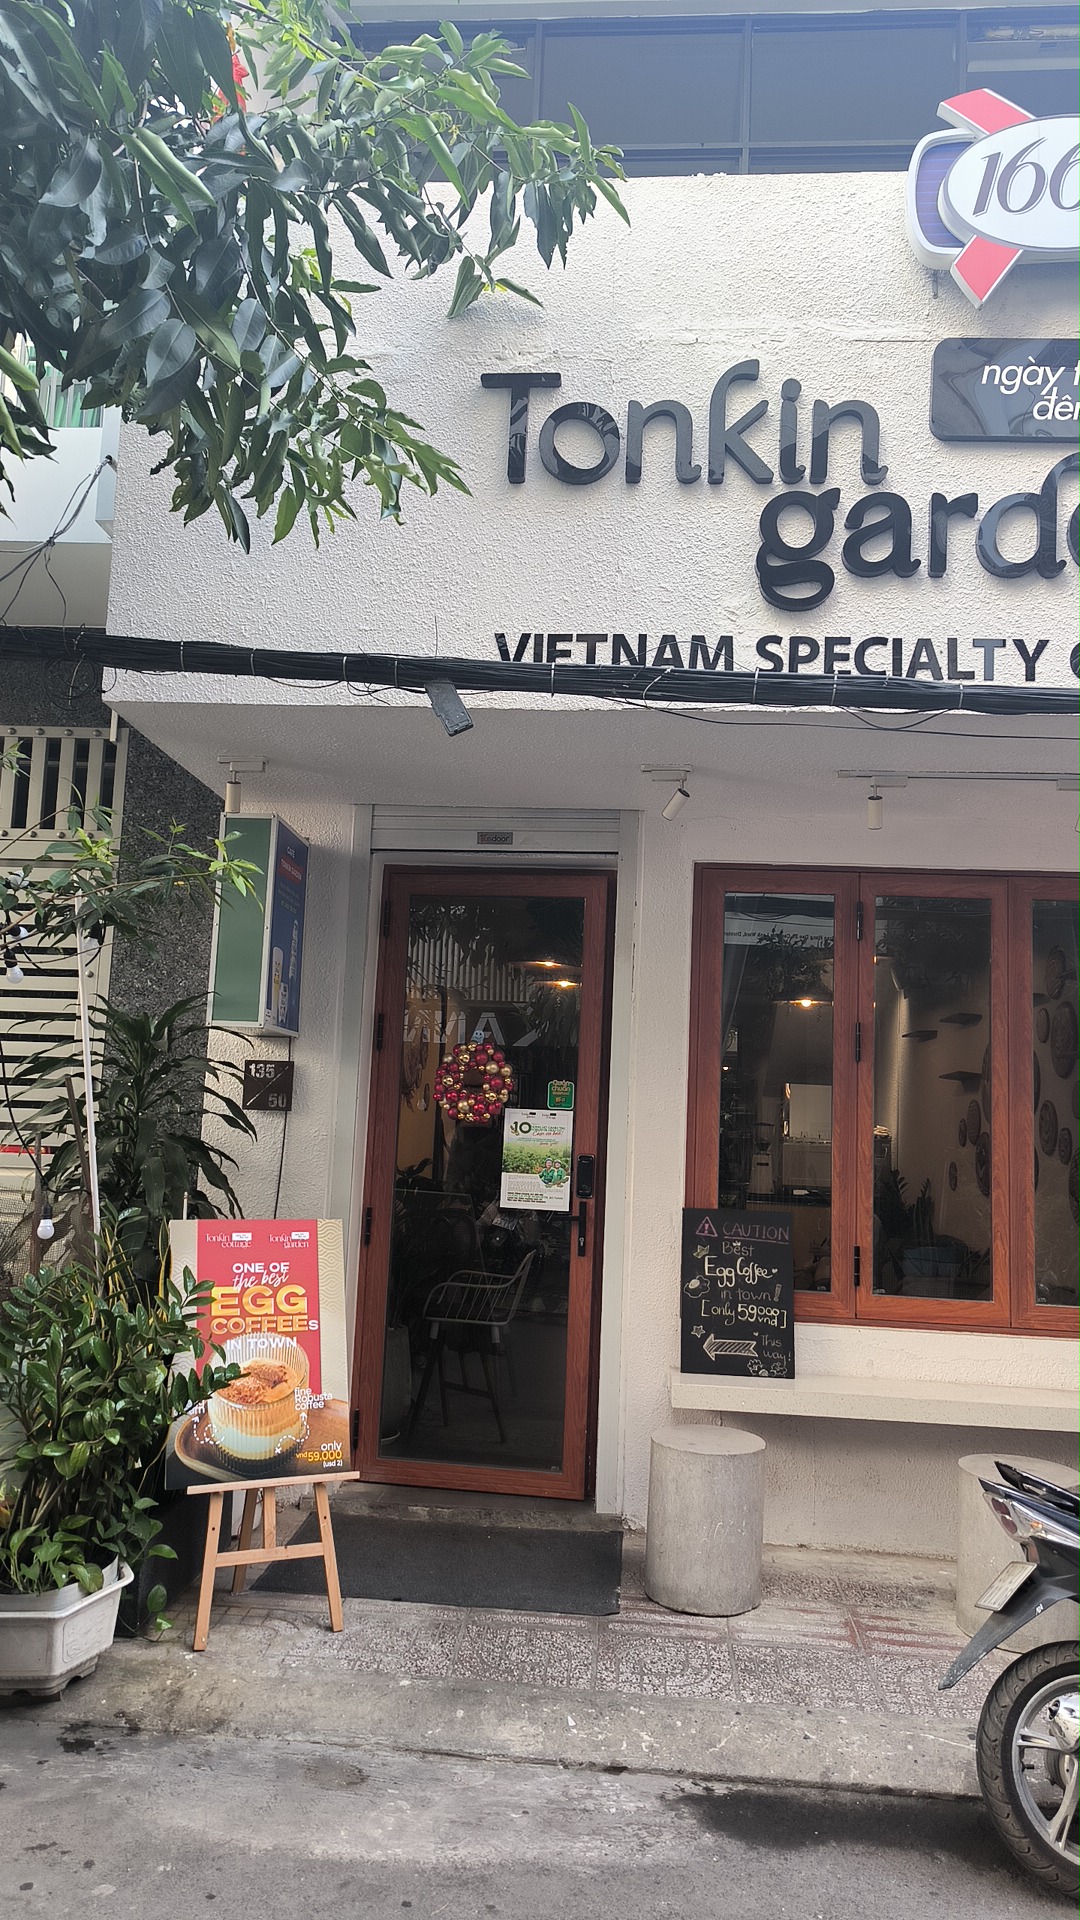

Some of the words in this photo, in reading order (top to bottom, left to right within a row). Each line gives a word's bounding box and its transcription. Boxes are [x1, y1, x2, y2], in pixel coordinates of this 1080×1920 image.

[981, 355, 1066, 395] ngày
[1033, 387, 1080, 421] đê
[481, 358, 888, 485] Tonkin
[755, 451, 1080, 612] gard
[494, 632, 734, 672] VIETNAM
[755, 635, 1050, 682] SPECIALTY
[249, 1063, 275, 1079] 135
[512, 1121, 532, 1134] 10
[206, 1232, 230, 1242] Tonkin
[269, 1233, 291, 1243] Tonkin
[722, 1221, 790, 1241] CAUTION
[722, 1241, 755, 1257] Best
[232, 1263, 265, 1273] ONE
[269, 1262, 290, 1272] OF
[704, 1256, 736, 1288] Egg
[736, 1256, 773, 1285] Coffee
[232, 1273, 259, 1291] the
[261, 1268, 290, 1287] best
[211, 1284, 308, 1316] EGG
[720, 1289, 732, 1300] in
[226, 1338, 241, 1350] IN
[247, 1336, 297, 1350] TOWN
[760, 1335, 782, 1348] This
[294, 1387, 312, 1396] fine
[295, 1392, 333, 1403] Robusta
[295, 1400, 325, 1410] coffee
[321, 1441, 342, 1451] only
